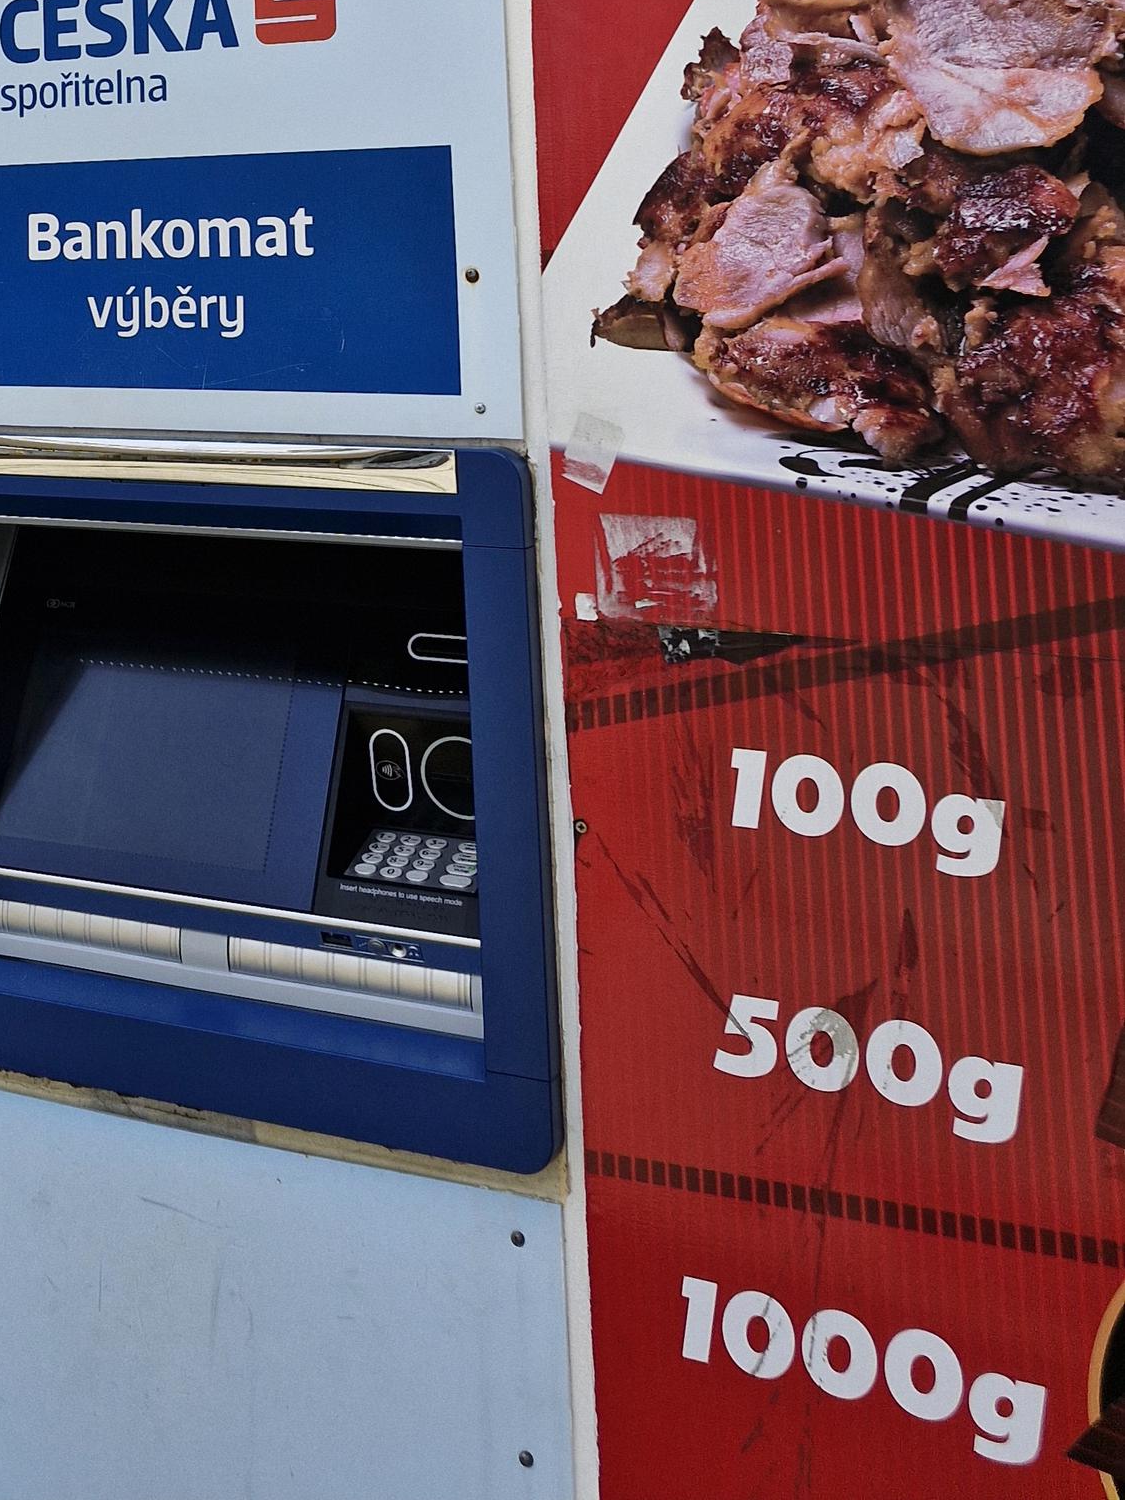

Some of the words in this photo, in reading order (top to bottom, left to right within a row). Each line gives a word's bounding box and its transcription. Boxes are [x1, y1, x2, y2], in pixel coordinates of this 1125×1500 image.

[0, 68, 168, 118] spořitelna
[28, 207, 314, 261] Bankomat
[87, 285, 245, 338] výběry
[730, 747, 1006, 878] 100g
[340, 883, 358, 892] Insert
[359, 885, 397, 897] headphones
[419, 894, 443, 904] speech
[443, 897, 463, 906] mode
[713, 993, 1024, 1144] 500g
[681, 1275, 1047, 1466] 1000g
